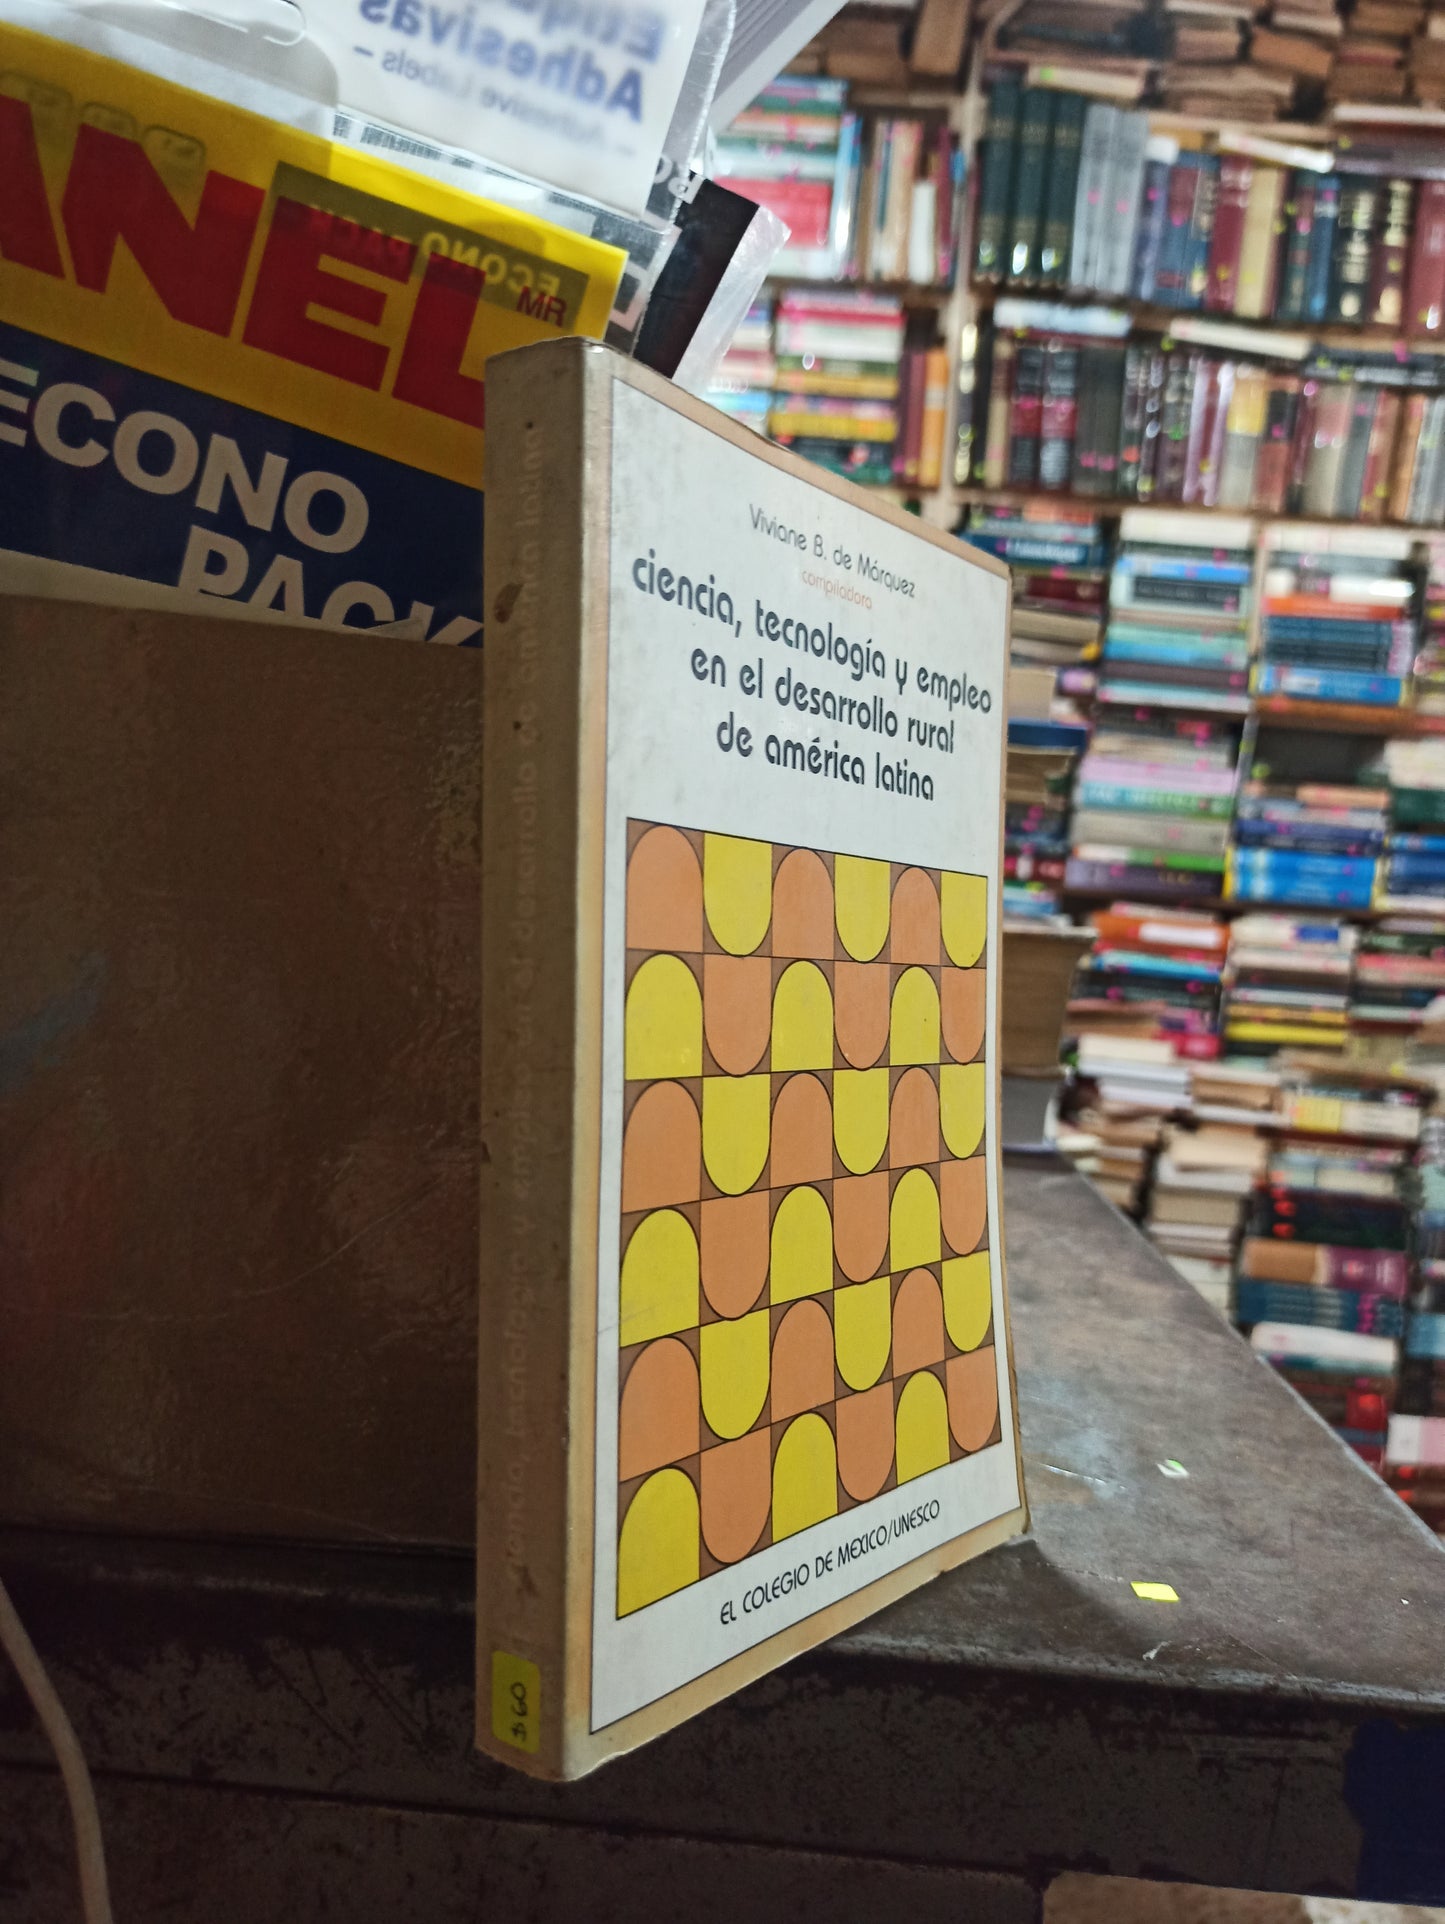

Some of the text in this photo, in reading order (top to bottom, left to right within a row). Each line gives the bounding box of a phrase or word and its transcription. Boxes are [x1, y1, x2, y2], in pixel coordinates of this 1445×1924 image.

[517, 285, 566, 327] MR
[749, 503, 916, 598] Viviane B. de Márquez
[801, 570, 873, 610] compiladora
[632, 548, 991, 713] ciencia, tecnología y empleo
[691, 647, 954, 753] en el desarrollo rural
[717, 711, 934, 801] de américa latina
[720, 1601, 737, 1625] EL
[743, 1564, 810, 1613] COLEGIO
[815, 1550, 833, 1579] DE
